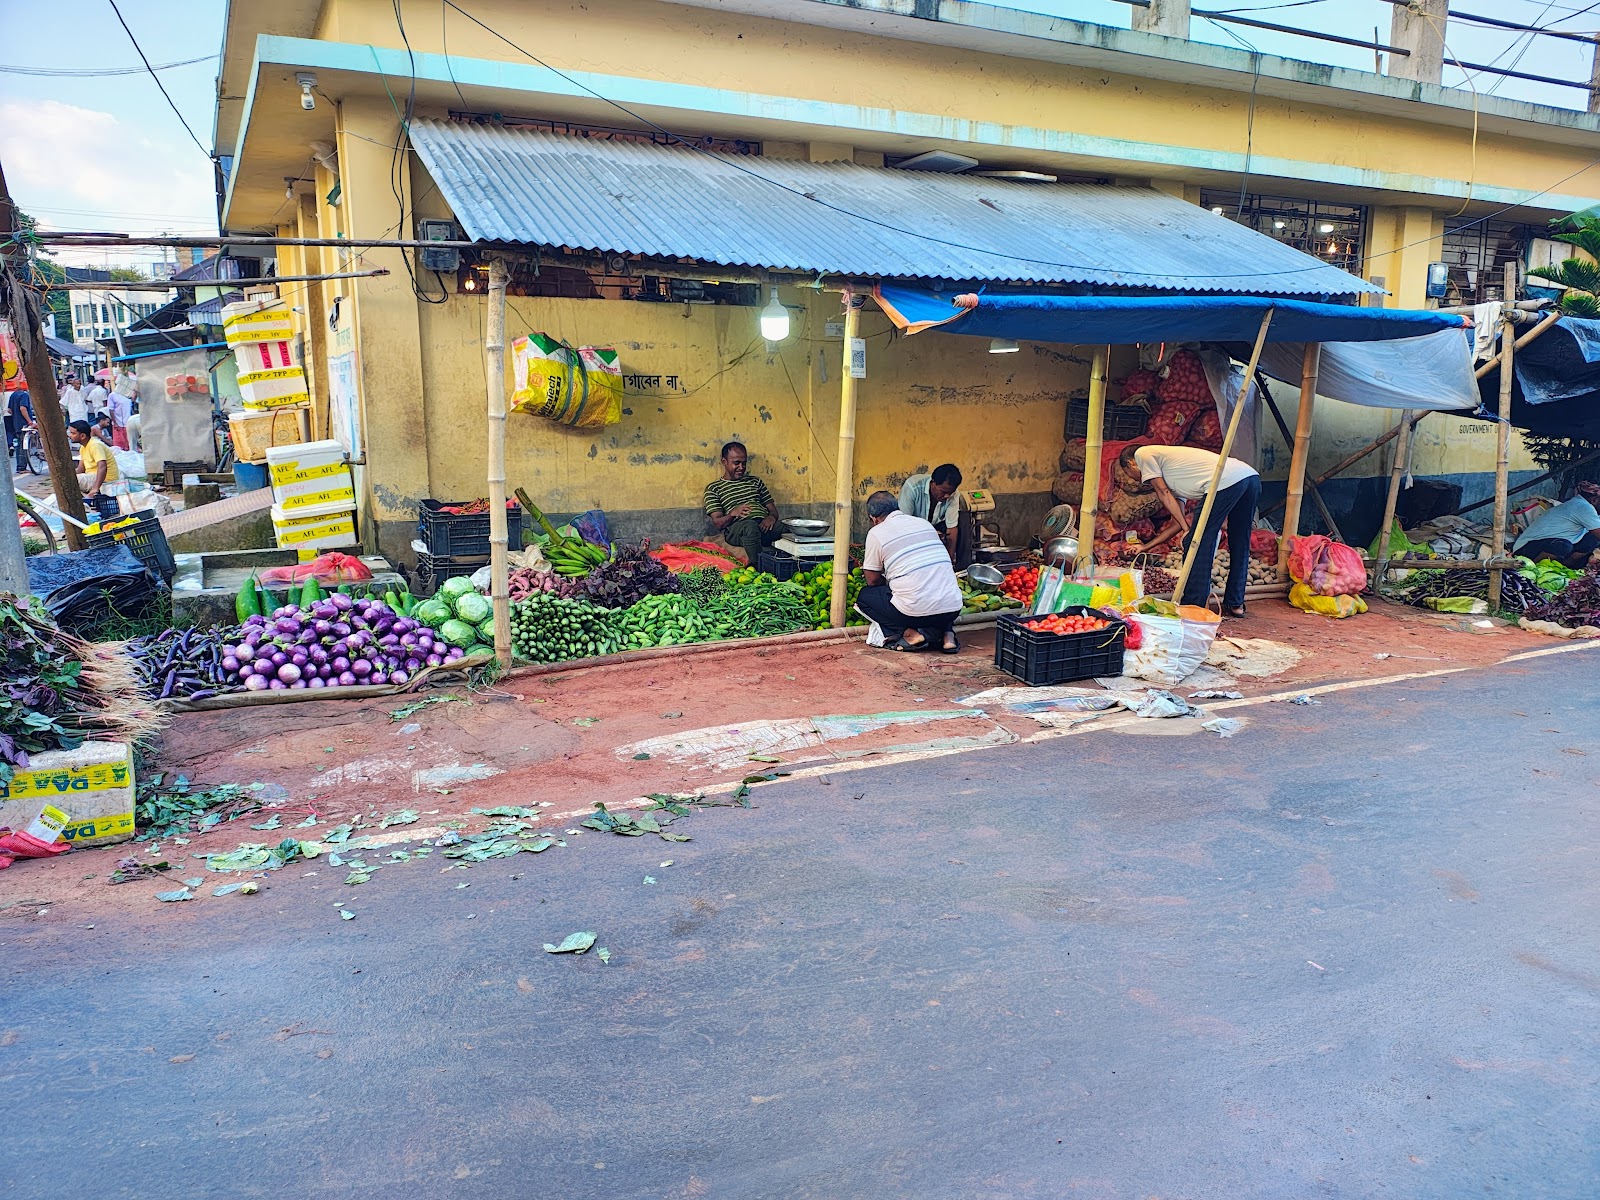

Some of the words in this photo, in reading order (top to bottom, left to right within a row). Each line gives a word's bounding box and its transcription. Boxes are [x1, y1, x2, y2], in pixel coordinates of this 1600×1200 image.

[1459, 425, 1493, 434] GOVERNMENT
[295, 471, 309, 480] AFL
[320, 466, 335, 474] AFL
[318, 492, 332, 500] AFL
[302, 530, 316, 539] AFL
[328, 525, 342, 533] AFL
